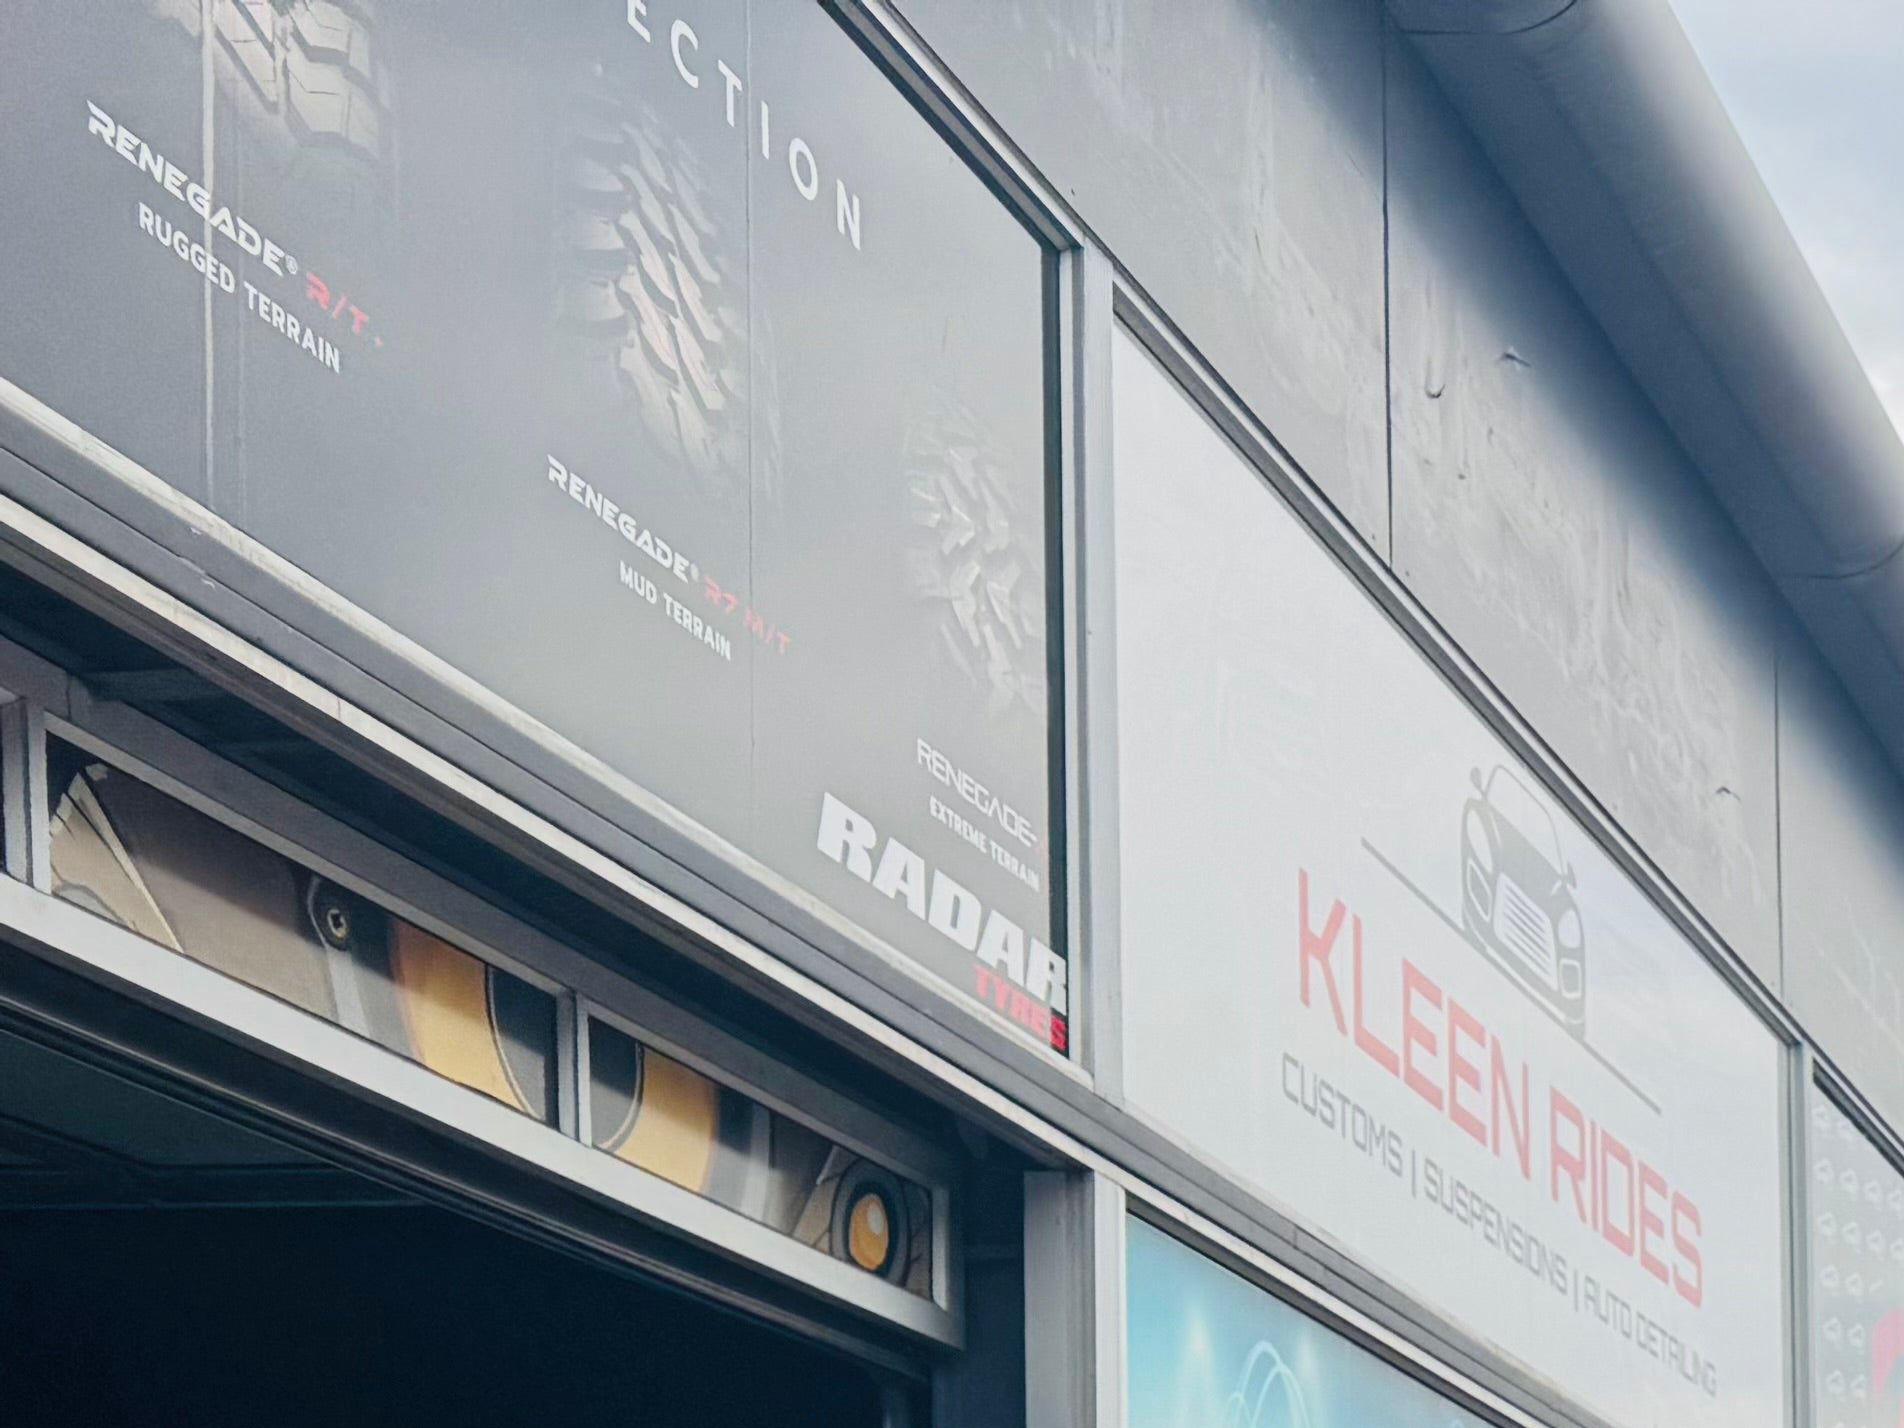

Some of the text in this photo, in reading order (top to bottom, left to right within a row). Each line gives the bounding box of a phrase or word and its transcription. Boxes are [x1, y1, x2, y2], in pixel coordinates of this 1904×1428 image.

[138, 201, 341, 374] RUGGED TERRAIN
[619, 559, 731, 661] MUD TERRAIN
[817, 791, 1068, 1018] RADAR
[929, 795, 1041, 893] EXTREME TERRAIN
[974, 962, 1068, 1052] TYRES
[1298, 866, 1703, 1310] KLEEN RIDES
[1282, 1052, 1717, 1398] CUSTOMS SUSPENSIONS AUTO DETAILING
